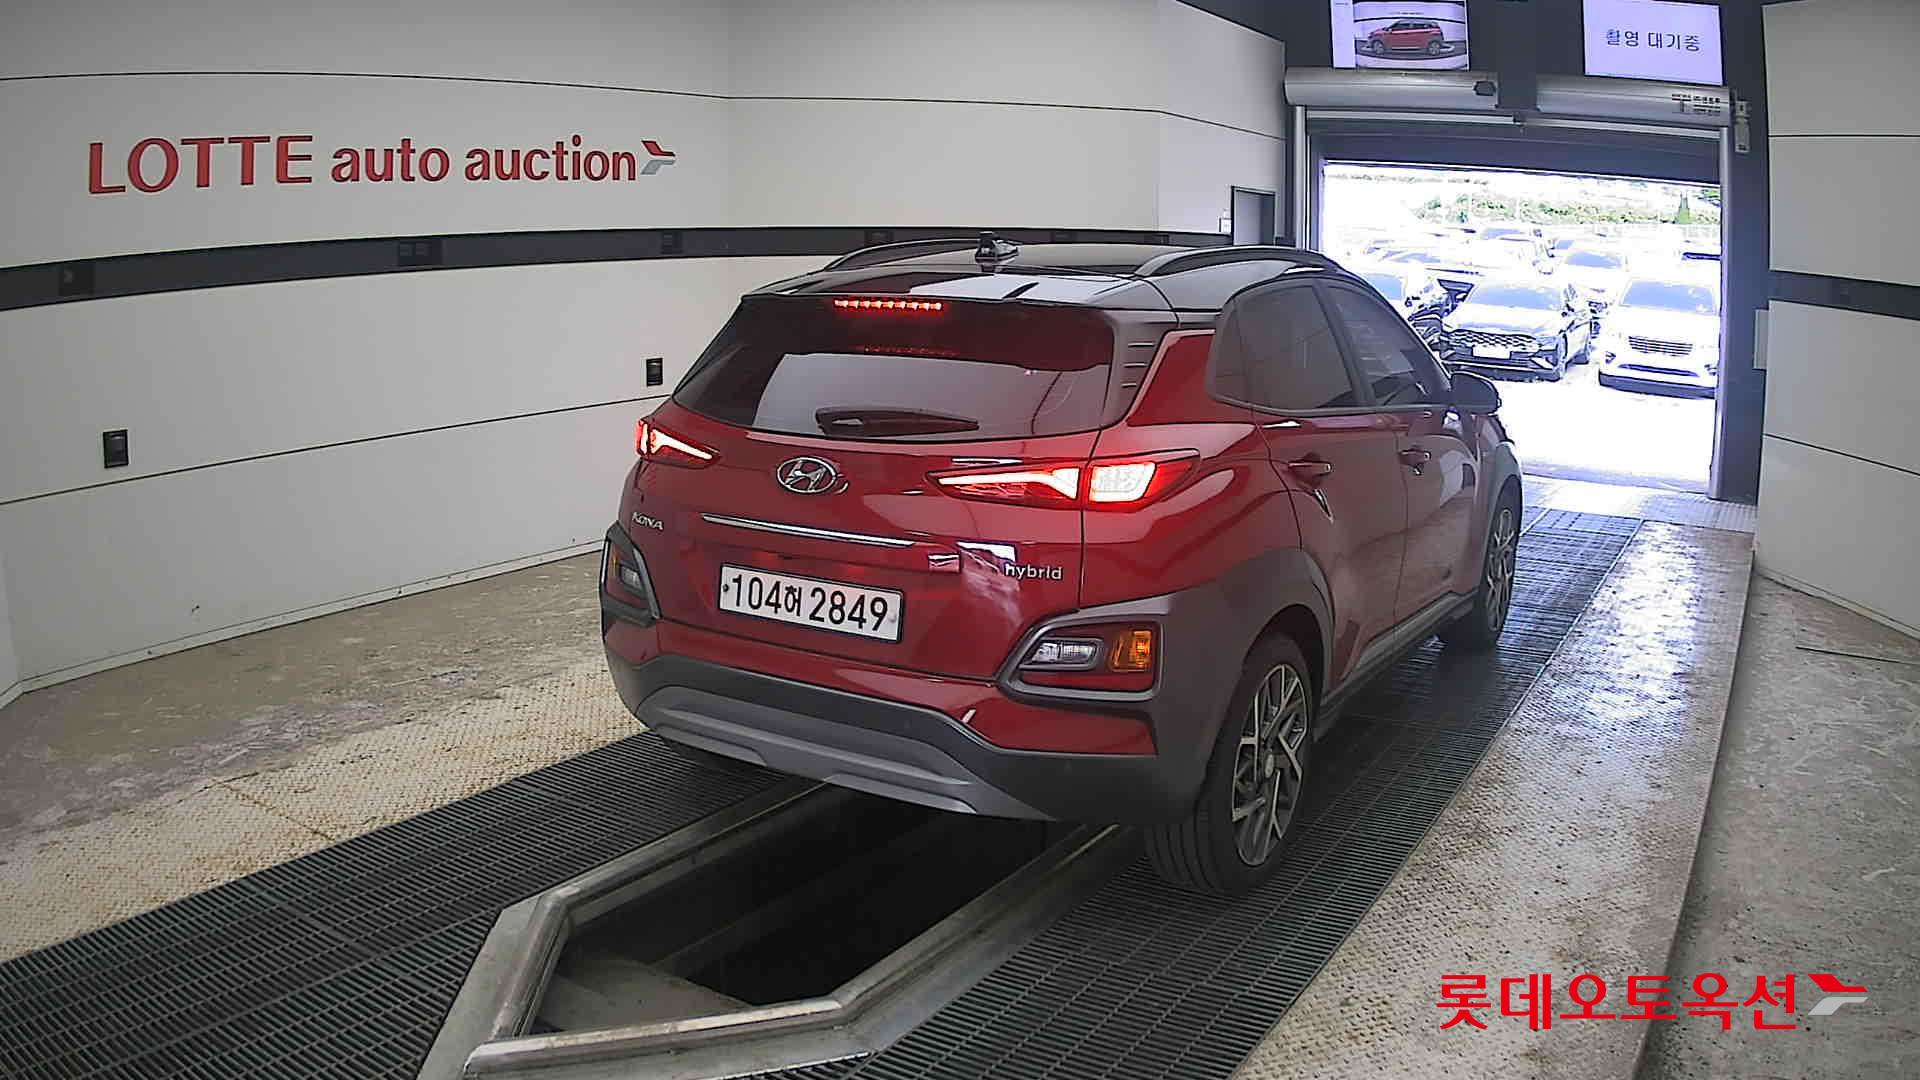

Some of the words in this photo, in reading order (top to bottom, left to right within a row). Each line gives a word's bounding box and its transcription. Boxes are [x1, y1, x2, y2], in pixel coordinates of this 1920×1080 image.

[1606, 29, 1639, 47] 촬영
[1647, 32, 1700, 52] 대기중
[89, 135, 313, 194] LOTTE
[330, 138, 450, 183] auto
[464, 134, 637, 182] auction
[632, 511, 664, 530] KONA
[1004, 562, 1063, 581] hybrid
[808, 586, 889, 632] 2849
